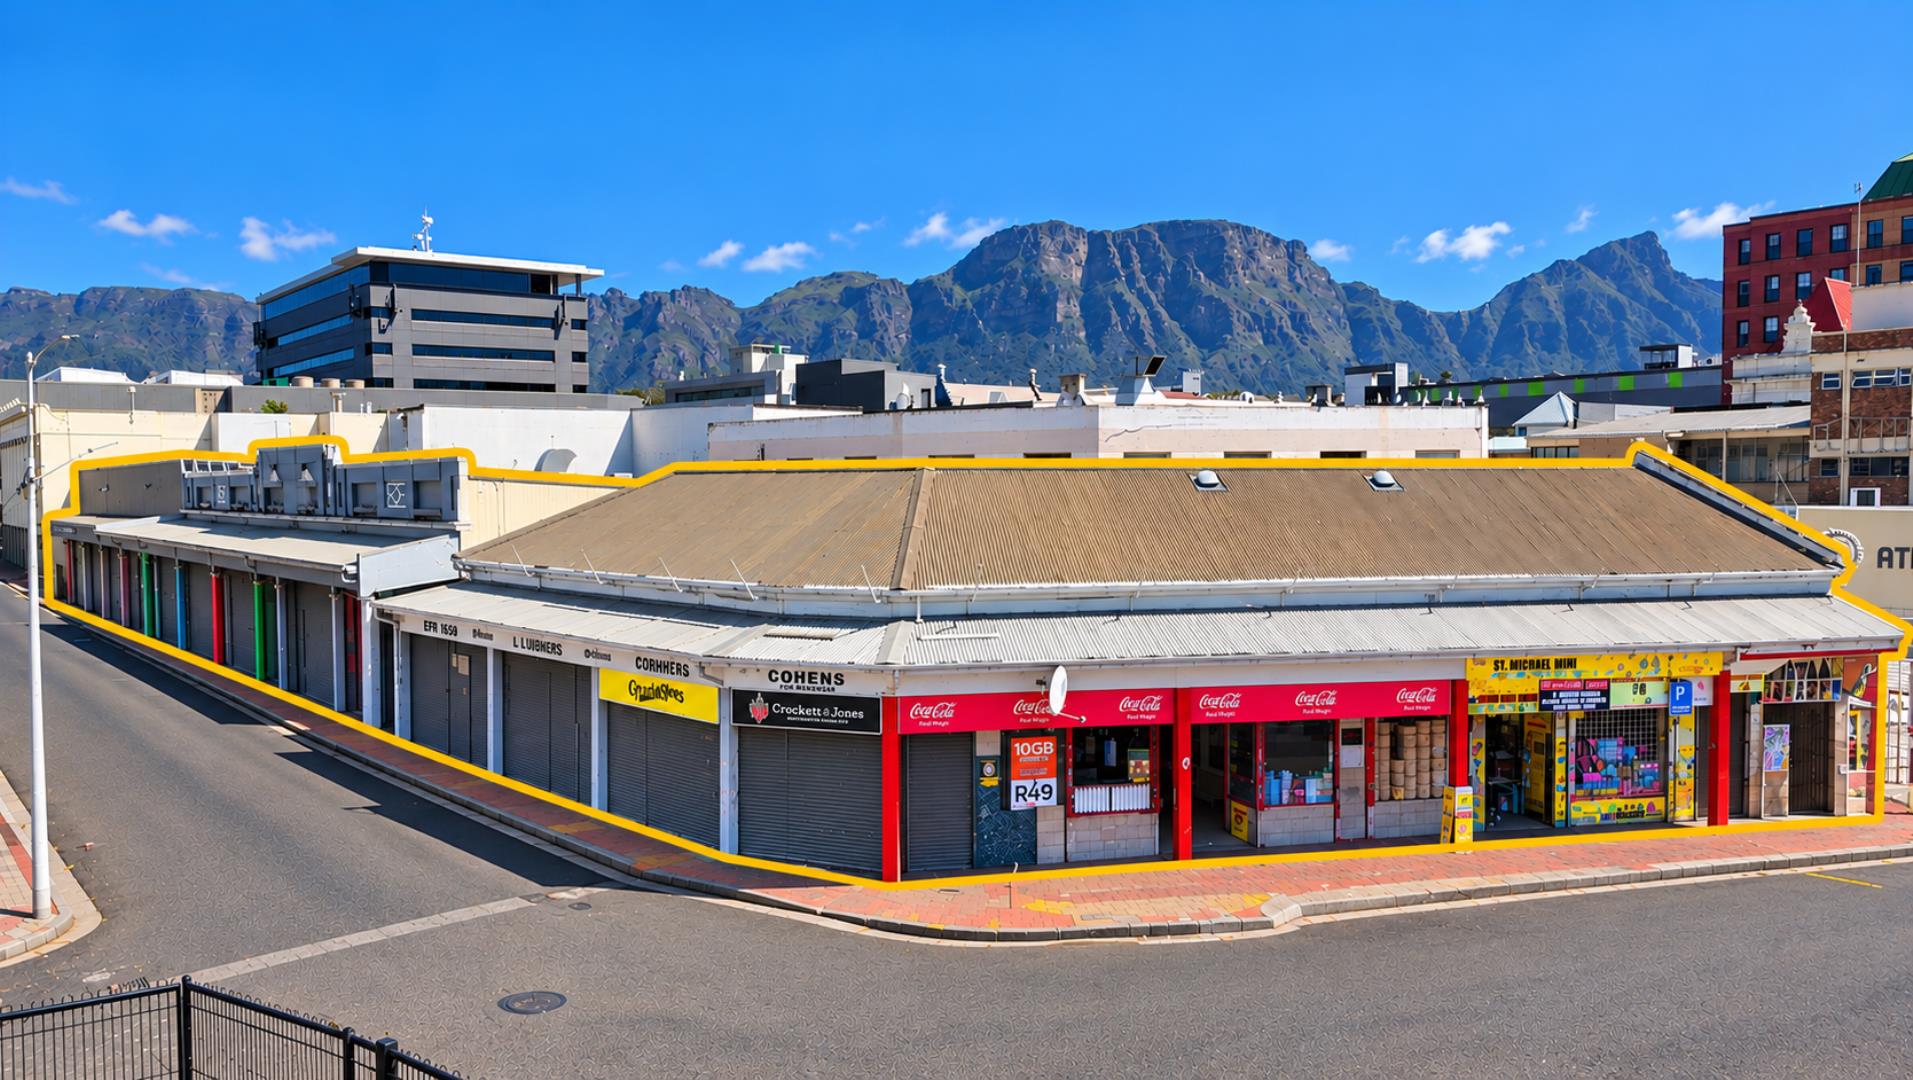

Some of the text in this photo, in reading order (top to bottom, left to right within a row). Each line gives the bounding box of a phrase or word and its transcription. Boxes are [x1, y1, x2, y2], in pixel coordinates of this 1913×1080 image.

[1877, 546, 1913, 569] AT
[768, 669, 845, 686] COHENS
[1676, 686, 1685, 701] P
[772, 703, 822, 716] Crockett
[830, 706, 865, 719] Jones
[1014, 742, 1054, 756] 10GB
[1015, 780, 1053, 803] R49
